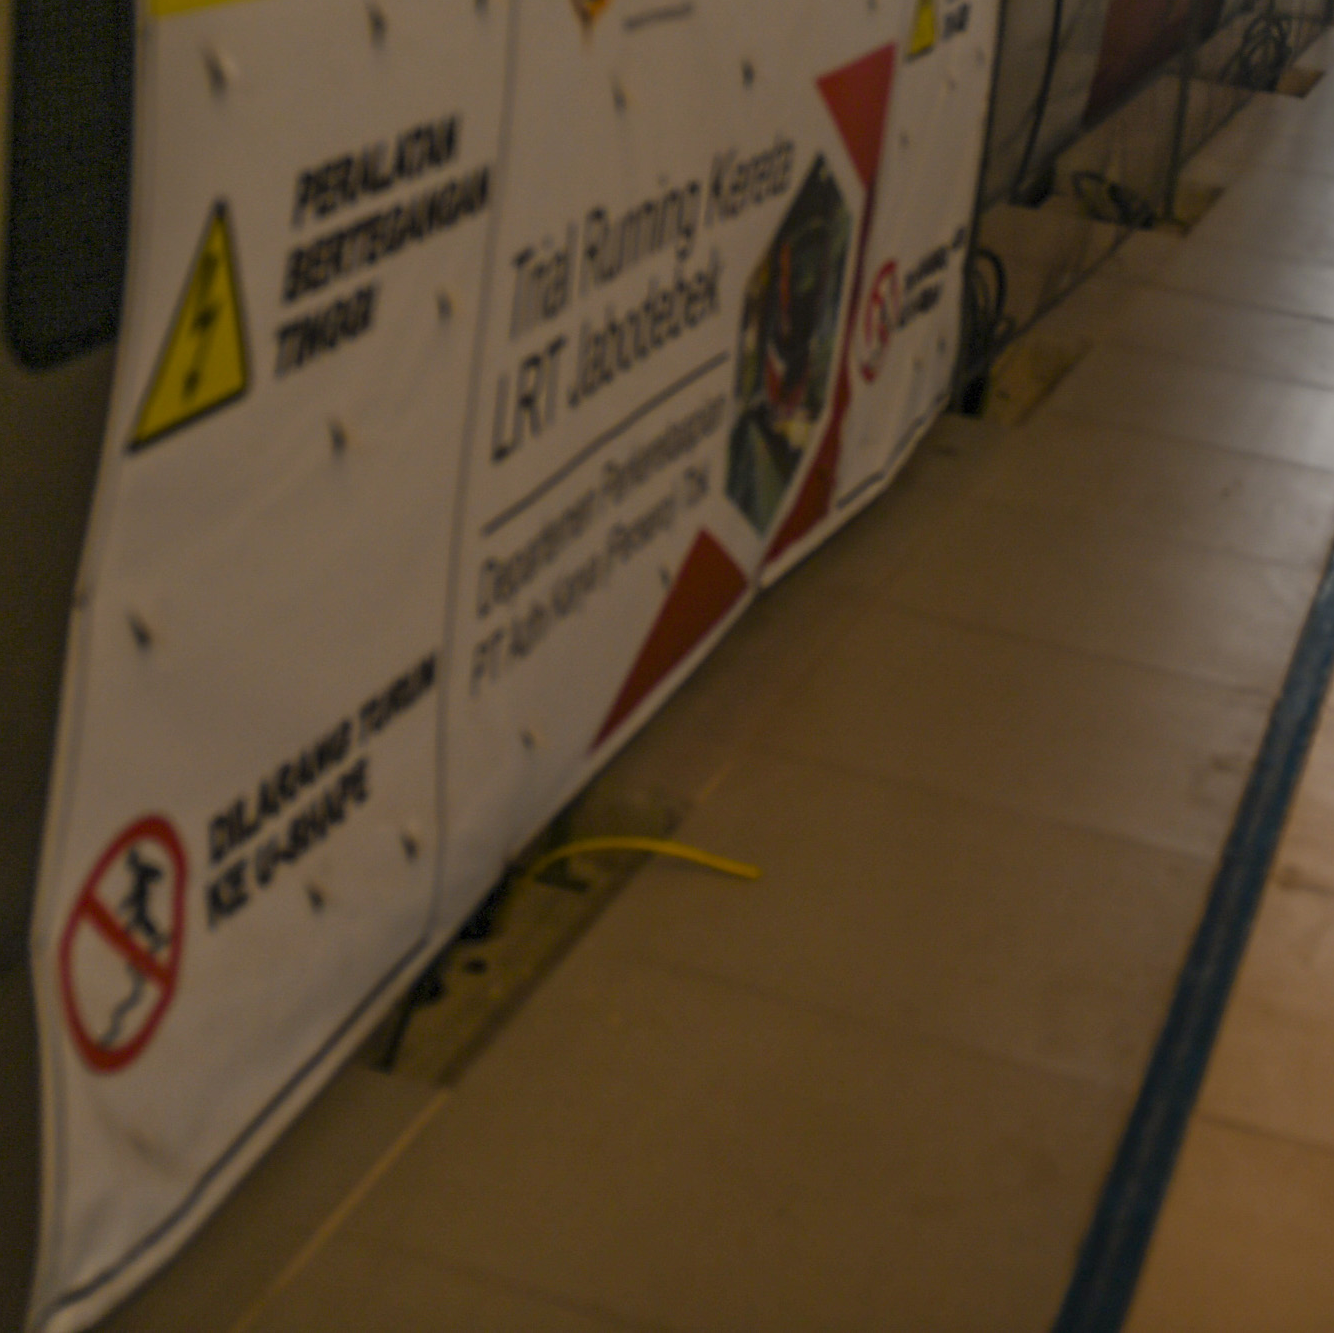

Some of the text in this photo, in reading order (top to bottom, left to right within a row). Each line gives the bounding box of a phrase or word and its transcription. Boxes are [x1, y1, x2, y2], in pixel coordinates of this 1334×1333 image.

[292, 113, 461, 228] PERALATAN
[509, 141, 797, 340] Trial Running Kereta
[491, 336, 567, 462] LRT
[568, 248, 723, 409] Jabodebek
